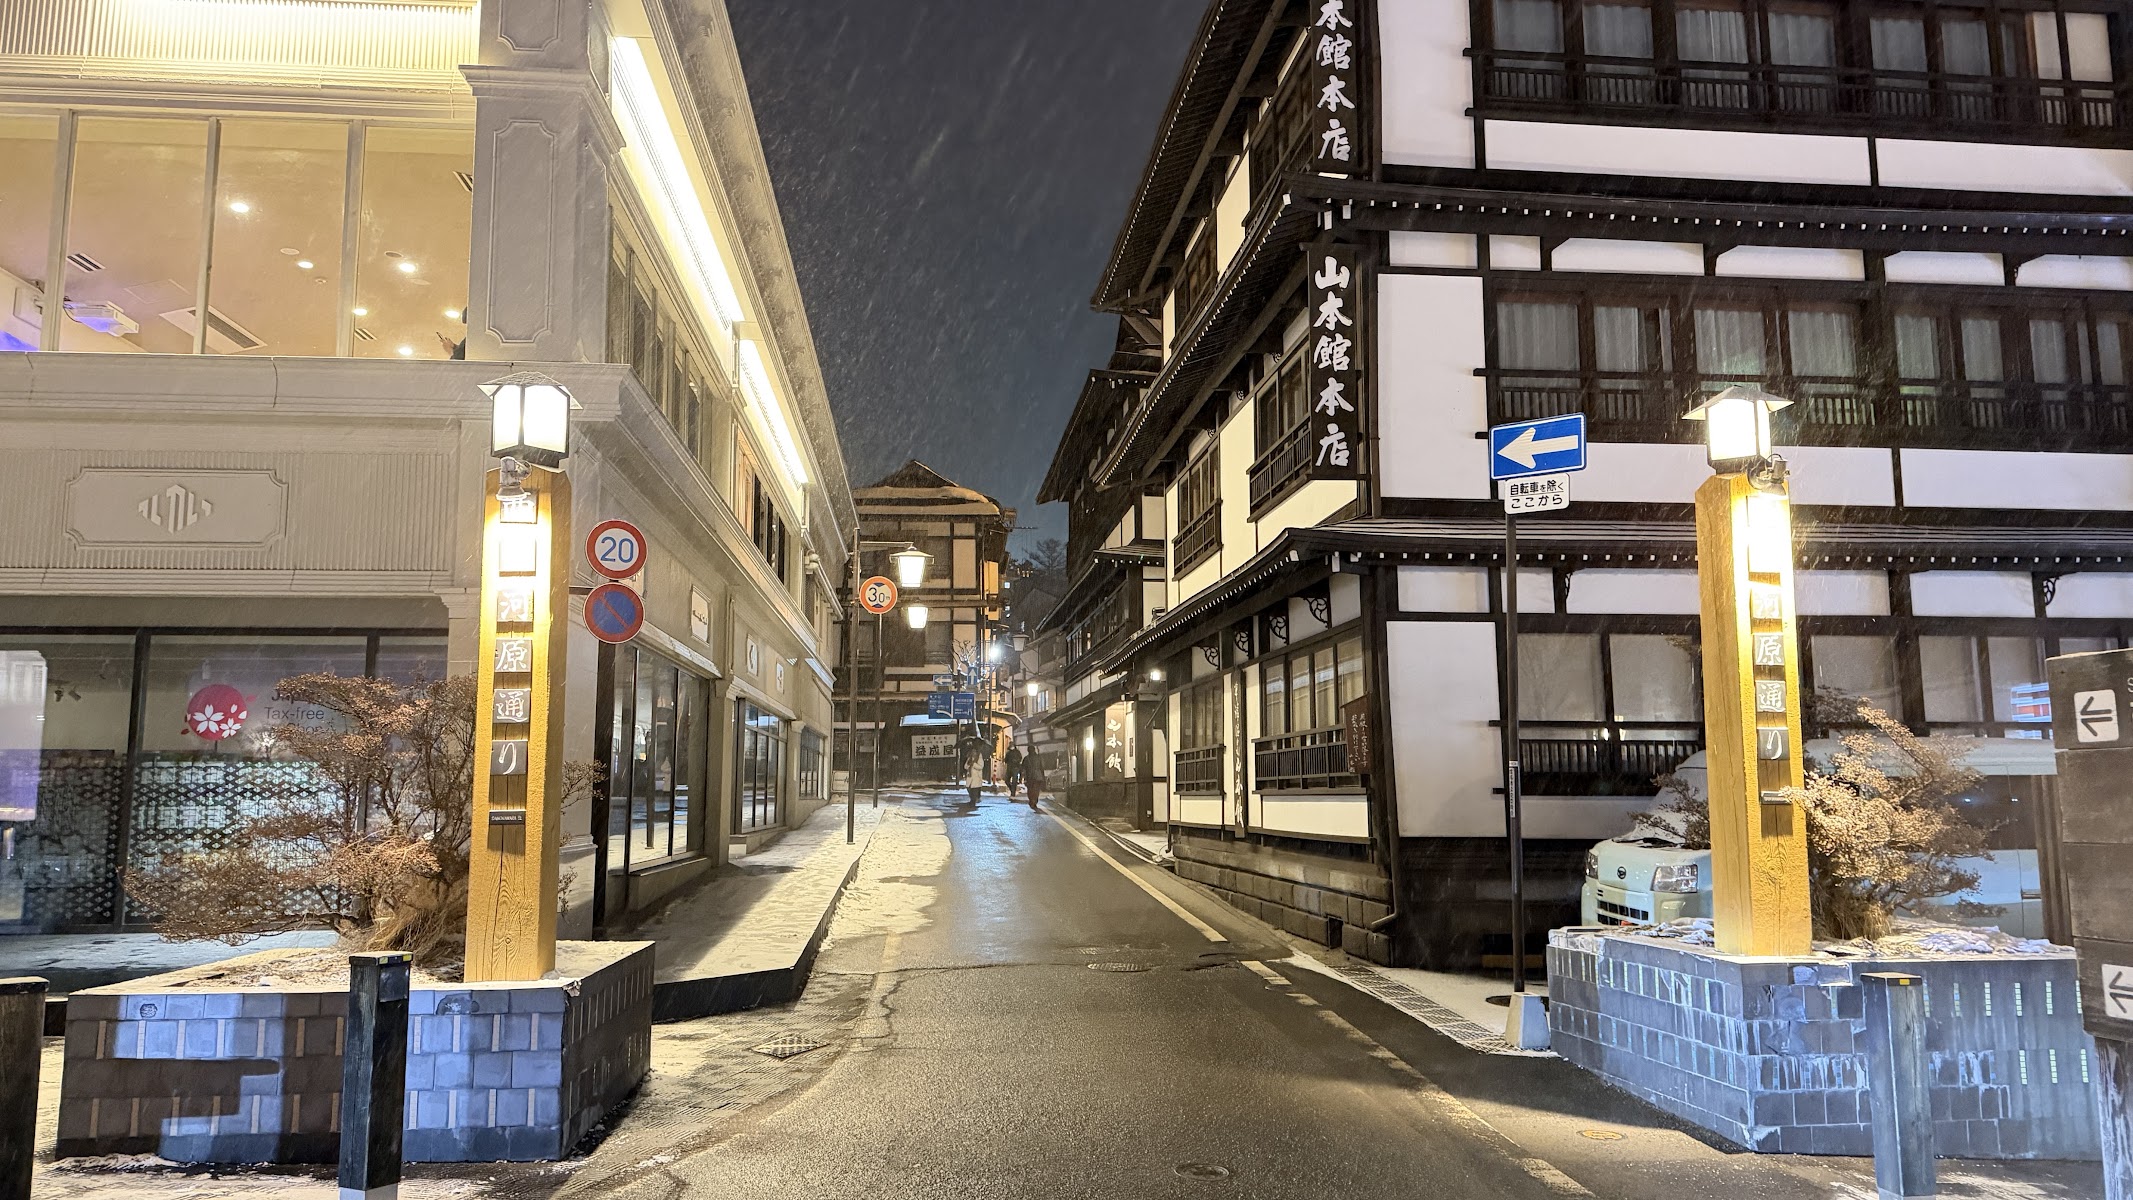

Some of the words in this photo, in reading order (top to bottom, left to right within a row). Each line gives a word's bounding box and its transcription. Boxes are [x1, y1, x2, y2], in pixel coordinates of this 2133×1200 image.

[1315, 0, 1355, 161] 本館本店
[1313, 256, 1354, 467] 山本館本店
[1510, 480, 1564, 495] 自転車を除く
[1511, 494, 1563, 509] ここから
[600, 536, 634, 563] 20
[495, 499, 535, 775] 西河原通り
[264, 706, 324, 720] Tax-free
[1105, 718, 1122, 773] 山本館
